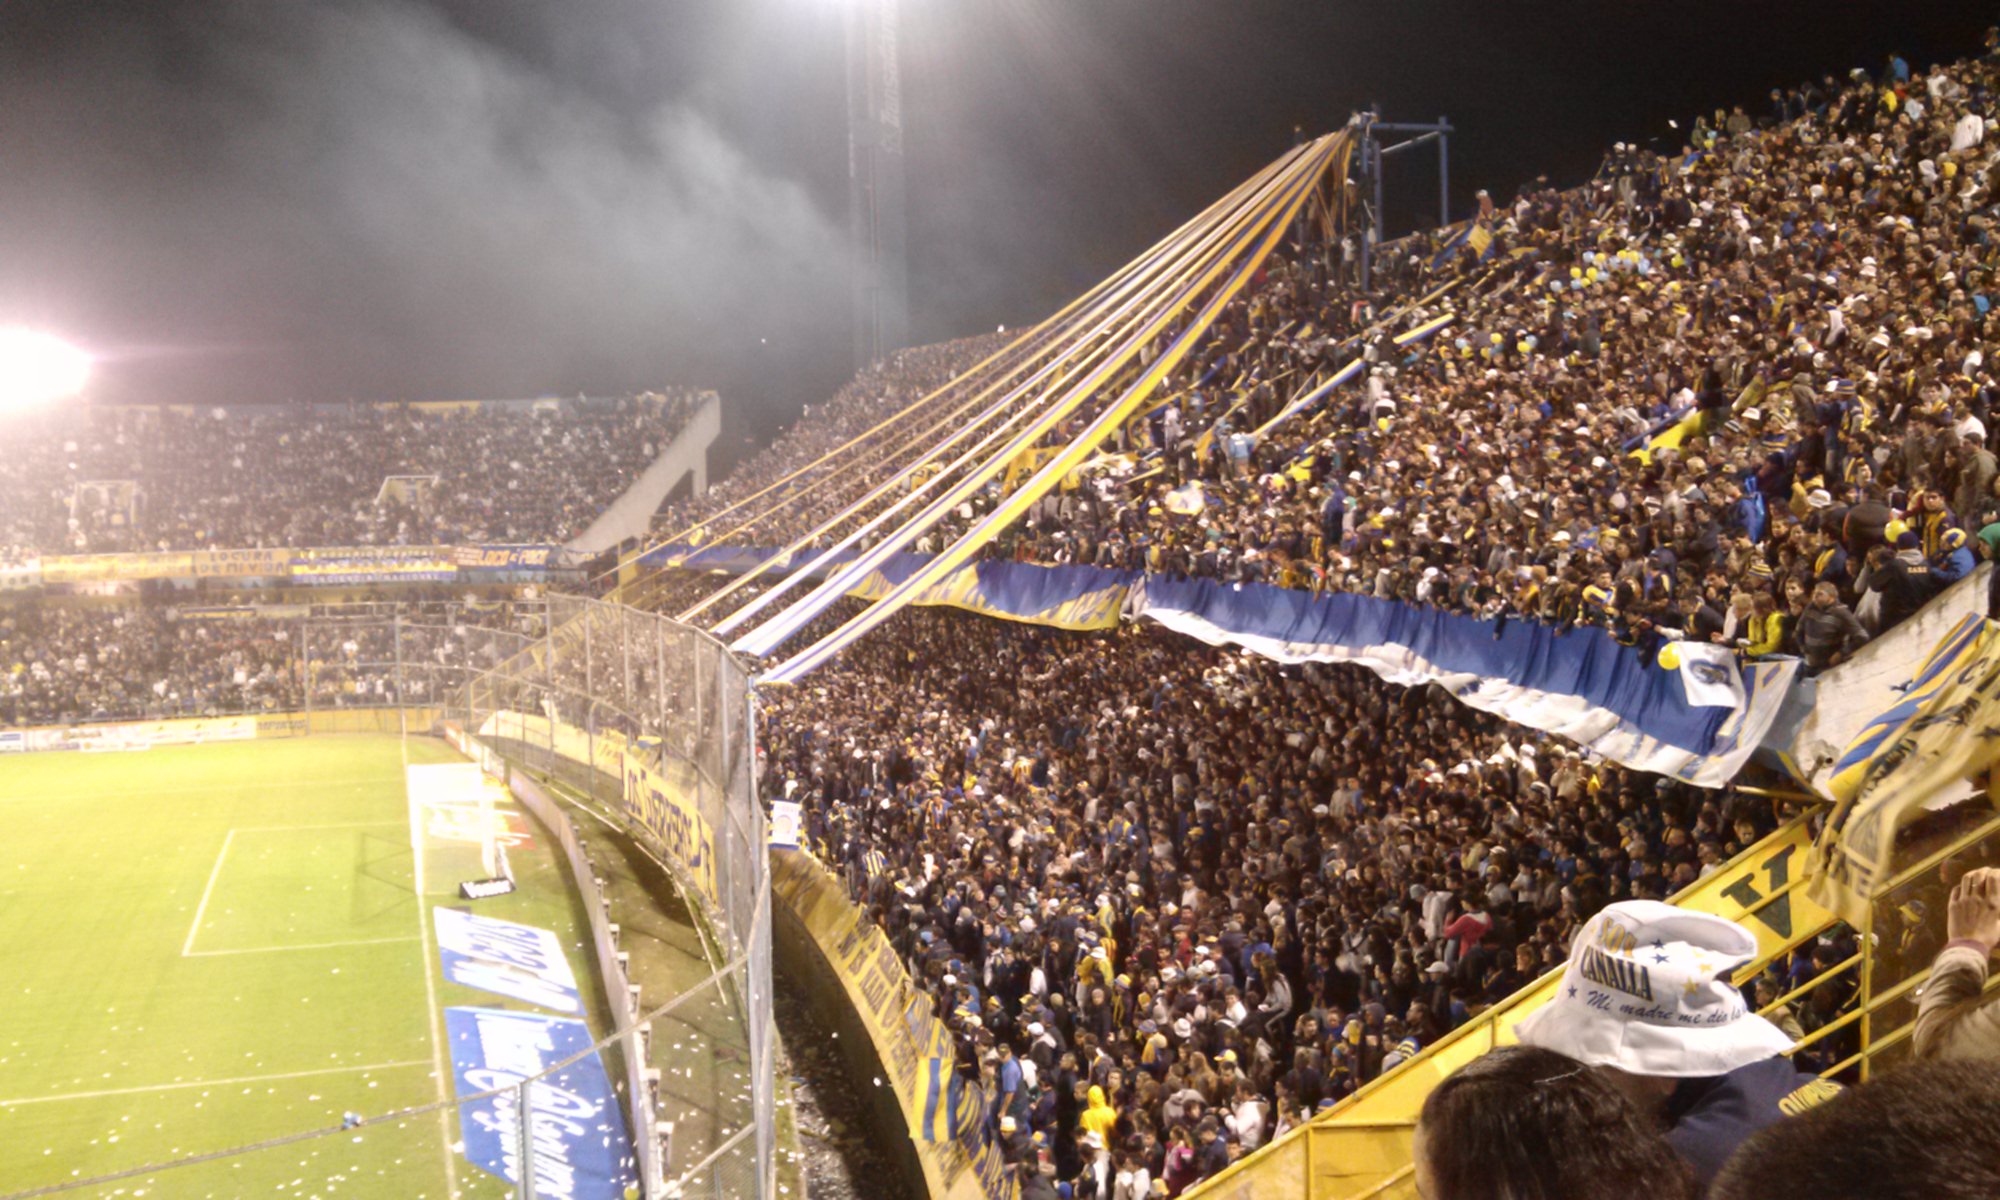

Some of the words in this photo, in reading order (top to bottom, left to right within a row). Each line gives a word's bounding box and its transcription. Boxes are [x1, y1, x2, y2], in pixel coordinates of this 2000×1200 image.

[210, 550, 273, 562] LOCURA
[200, 563, 220, 573] DE
[1580, 944, 1654, 1002] CANALLA
[1587, 990, 1612, 1011] Mi
[1619, 1003, 1674, 1020] madre
[1677, 1013, 1700, 1025] me
